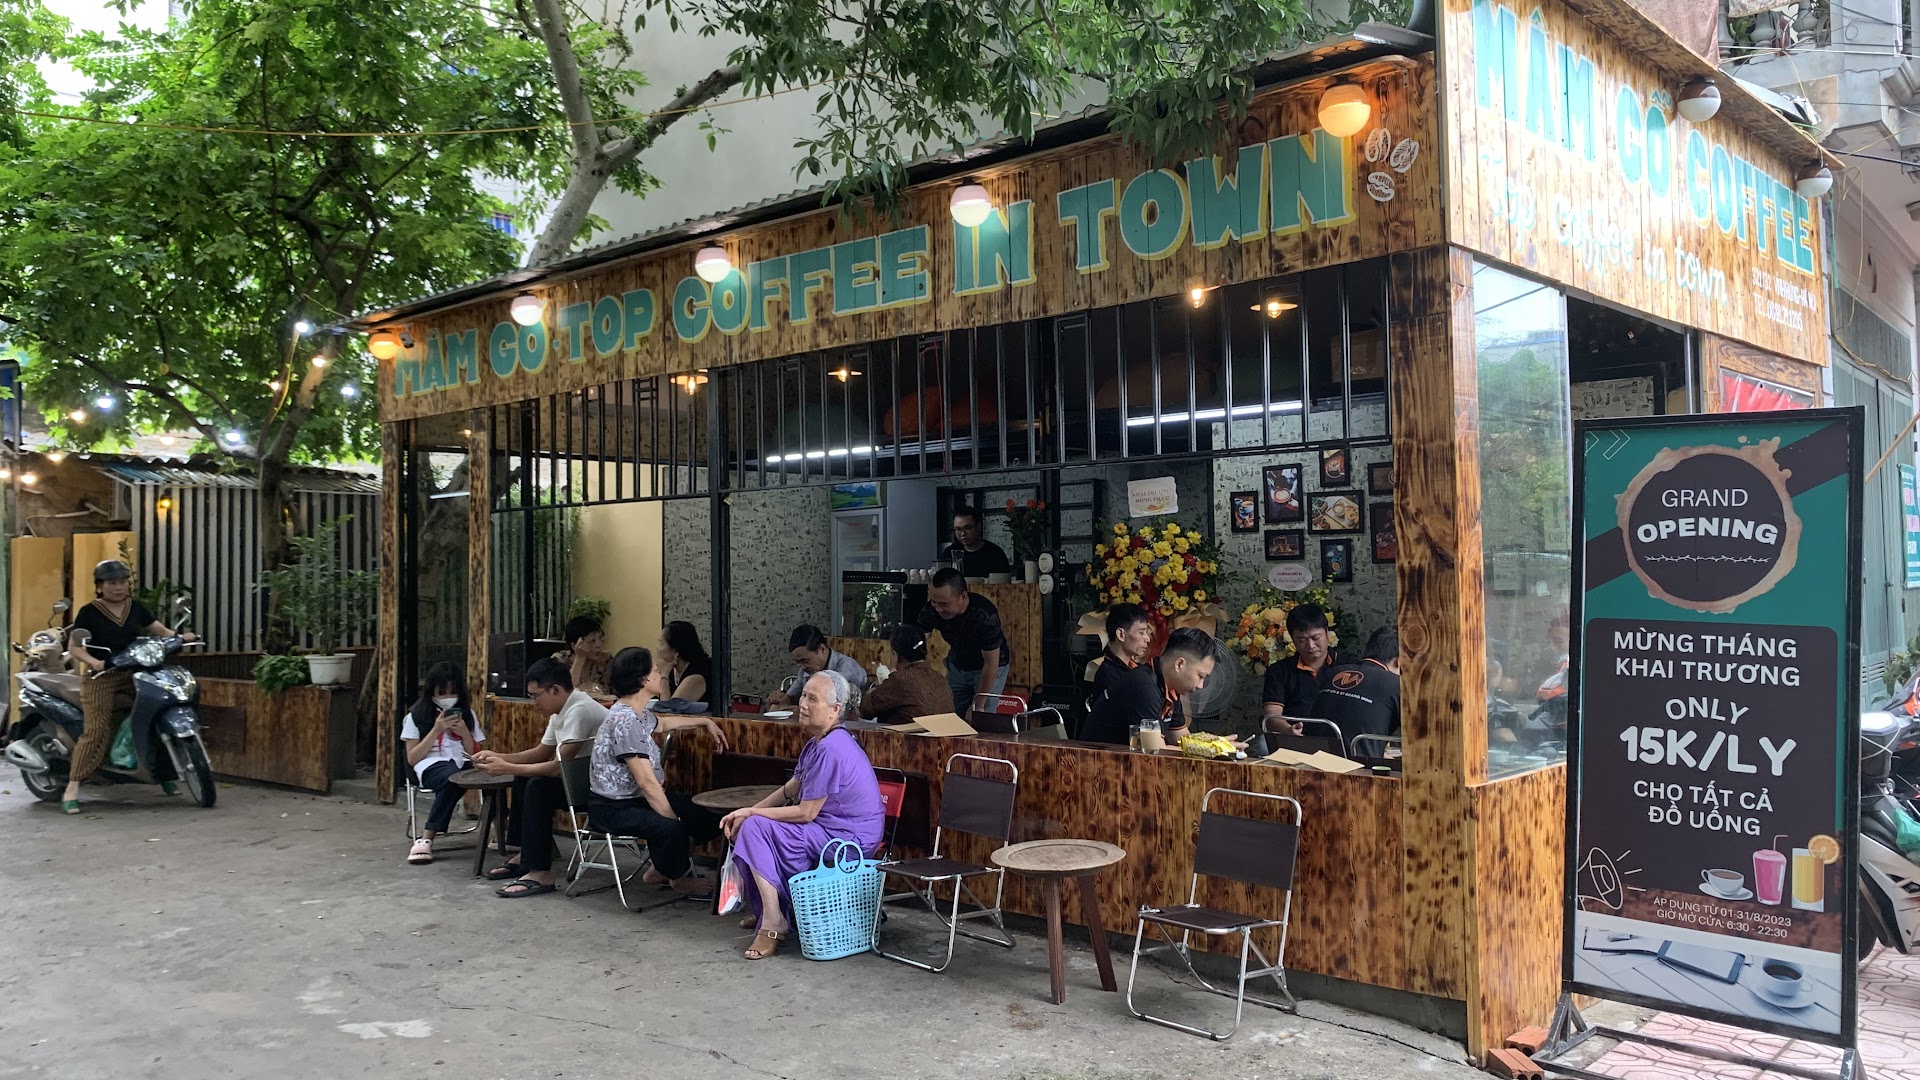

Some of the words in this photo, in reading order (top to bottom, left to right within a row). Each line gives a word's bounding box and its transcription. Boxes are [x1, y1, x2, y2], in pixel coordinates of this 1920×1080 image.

[1472, 0, 1597, 164] MÂM
[1686, 128, 1815, 280] COFFEE
[395, 327, 481, 399] MÂM
[560, 288, 657, 365] TOP
[672, 223, 932, 343] COFFEE
[952, 200, 1037, 296] IN
[1057, 127, 1357, 274] TOWN
[1644, 232, 1668, 284] in
[1673, 235, 1729, 305] town
[1661, 488, 1749, 508] GRAND
[1636, 517, 1779, 545] OPENING
[1614, 627, 1694, 653] MỪNG
[1701, 632, 1797, 659] THÁNG
[1616, 657, 1674, 679] KHAI
[1681, 661, 1800, 687] TRƯƠNG
[997, 699, 1018, 708] preme
[1665, 696, 1750, 725] ONLY
[1619, 725, 1797, 776] 15K/LY
[1633, 780, 1683, 801] CHO
[1689, 780, 1734, 807] TẤT
[1739, 788, 1774, 812] CẢ
[1648, 800, 1682, 826] ĐỒ
[1689, 805, 1761, 836] UỐNG
[1653, 897, 1667, 906] ÁP
[1669, 900, 1701, 912] DỤNG
[1702, 903, 1719, 915] TỪ
[1720, 907, 1792, 927] 01-31/8/2023
[1656, 908, 1677, 919] GIỜ
[1678, 910, 1697, 923] MỞ
[1698, 914, 1725, 928] CỬA:
[1726, 920, 1750, 932] 6:30
[1757, 925, 1788, 938] 22:30
